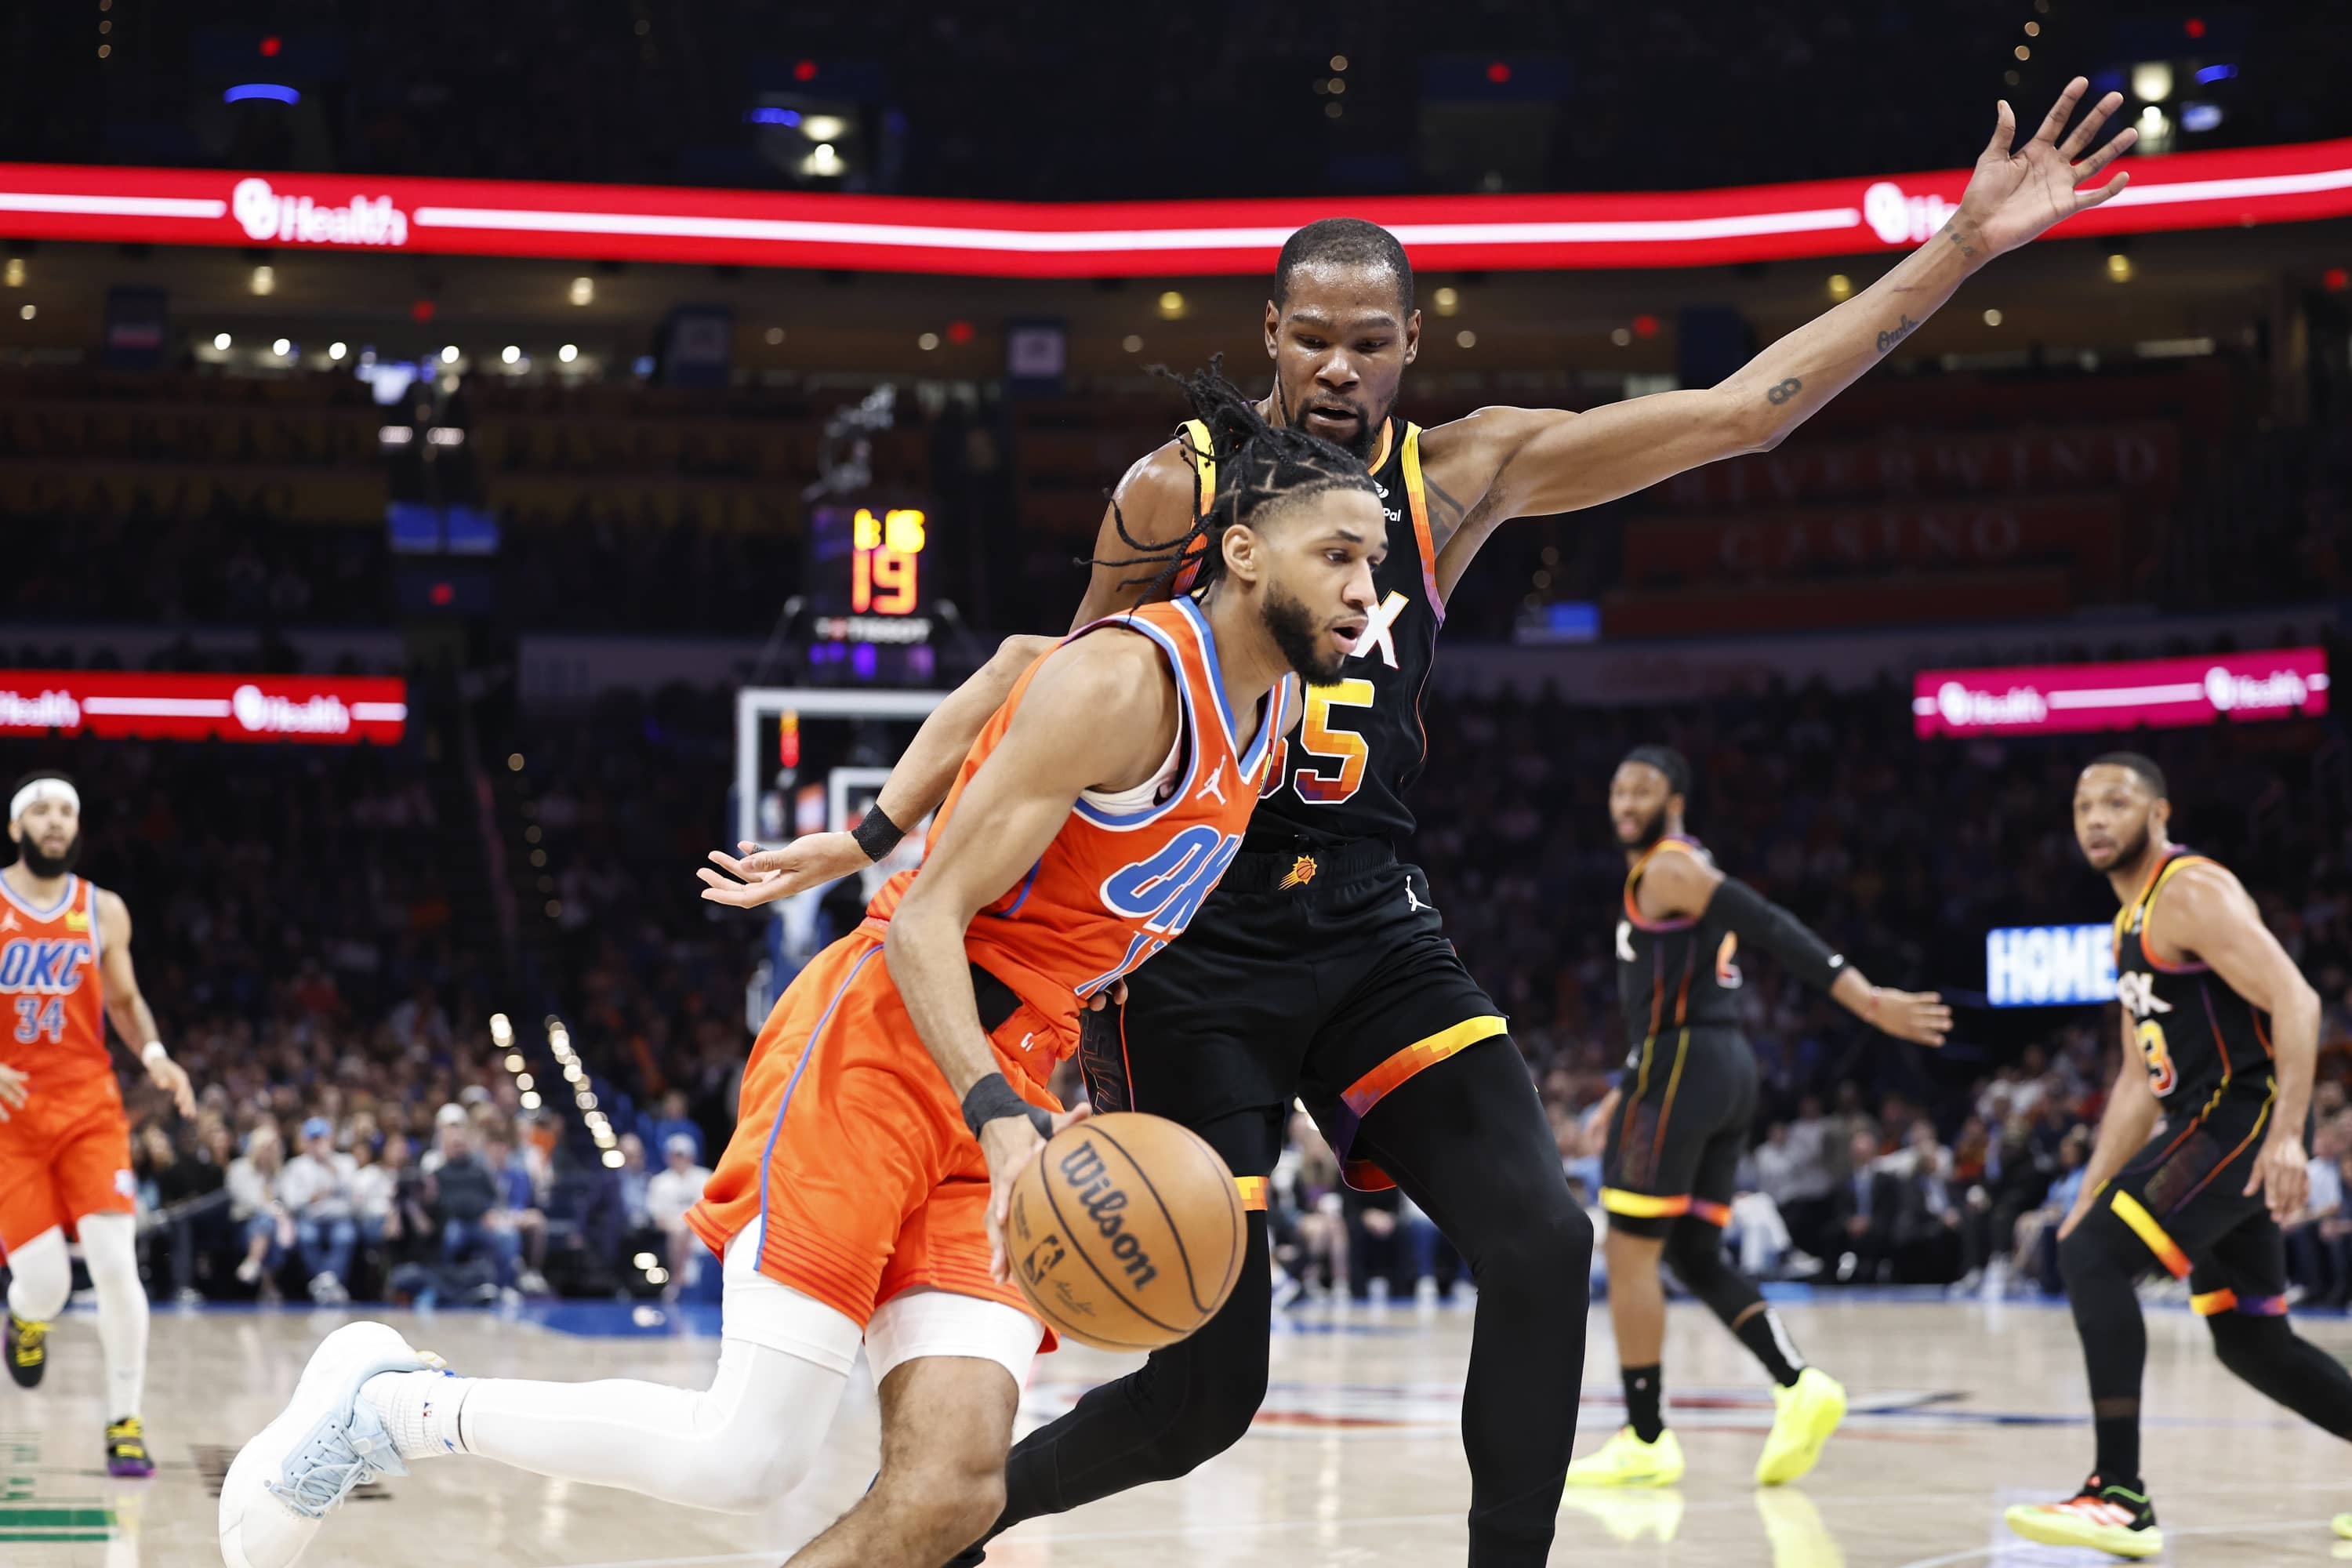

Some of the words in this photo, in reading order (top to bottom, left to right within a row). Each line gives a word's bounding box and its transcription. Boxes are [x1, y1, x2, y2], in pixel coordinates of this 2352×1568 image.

[278, 194, 408, 245] Health
[0, 937, 93, 995] OKC
[1987, 925, 2118, 1006] HOME
[14, 995, 67, 1044] 34
[1060, 1140, 1159, 1292] Wilson
